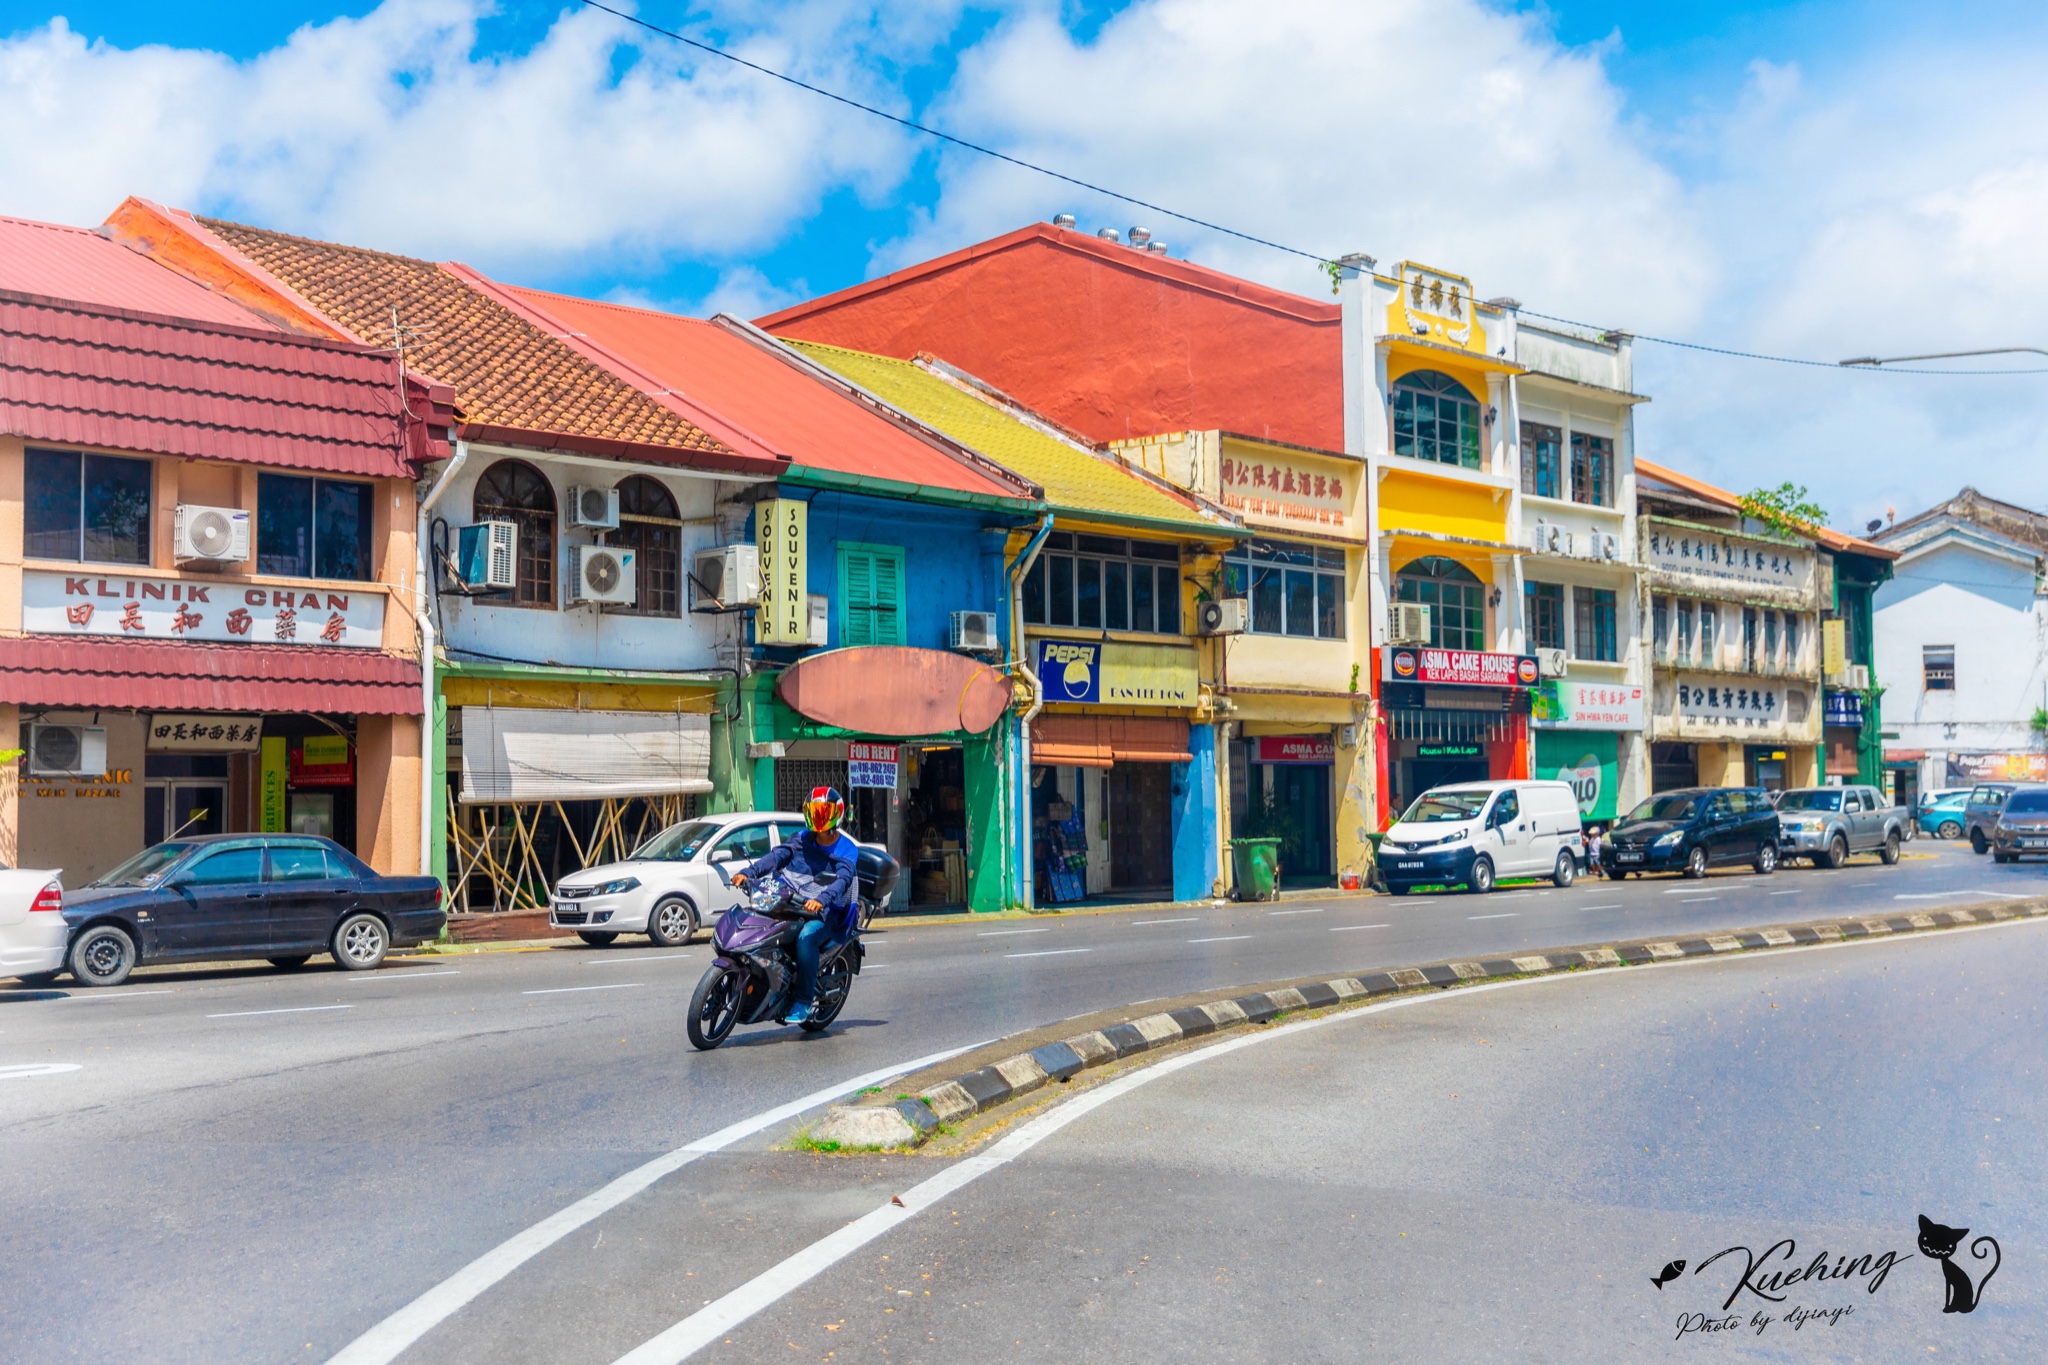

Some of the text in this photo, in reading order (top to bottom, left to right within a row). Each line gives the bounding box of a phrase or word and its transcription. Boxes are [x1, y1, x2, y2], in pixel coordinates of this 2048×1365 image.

[762, 508, 773, 635] SOUVENIR
[788, 508, 799, 635] SOUVENIR
[66, 577, 349, 611] KLINIK CHAN
[67, 601, 347, 643] 田長和西藥房
[1044, 644, 1095, 665] PEPSI
[1420, 651, 1515, 674] ASMA CAKE HOUSE
[1427, 668, 1509, 683] KEK LAPIS BASAH SARAWAK
[1575, 711, 1586, 722] SIN
[1602, 712, 1613, 723] YEN
[1614, 713, 1629, 723] CAFE
[850, 744, 896, 761] FOR RENT
[1282, 743, 1313, 755] ASMA
[37, 789, 68, 798] MAIN
[76, 789, 121, 798] BAZAAR
